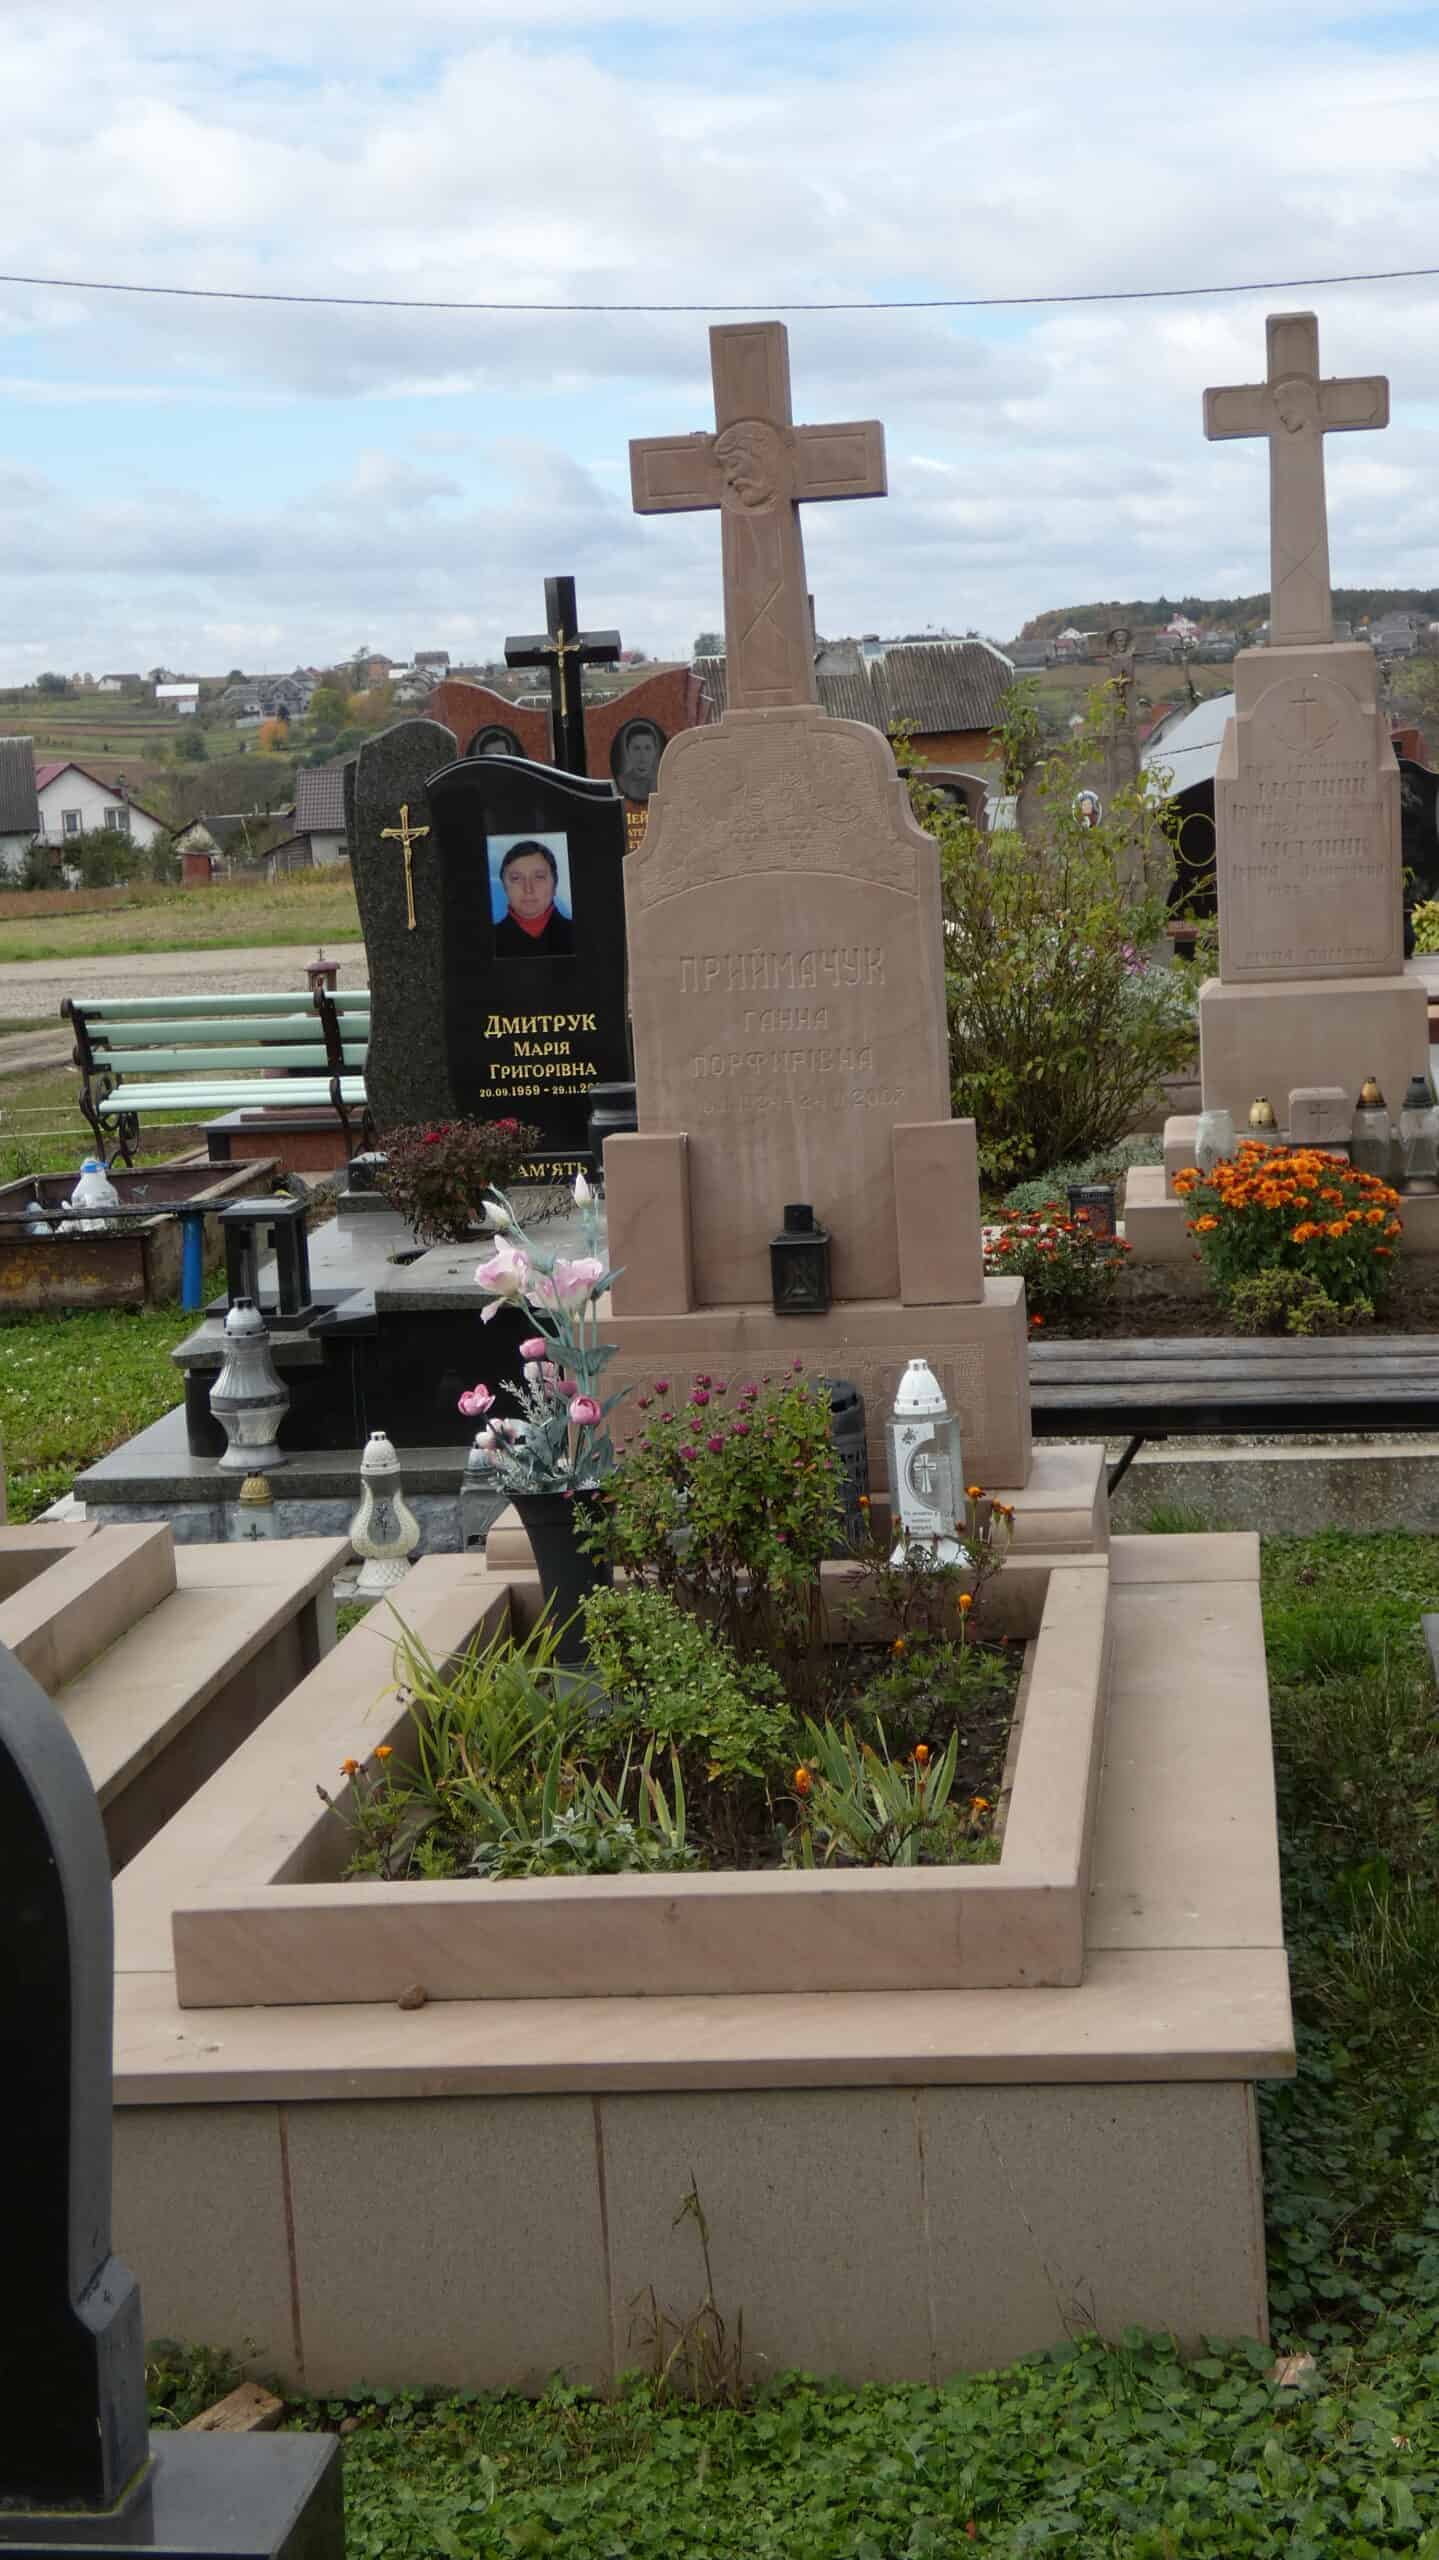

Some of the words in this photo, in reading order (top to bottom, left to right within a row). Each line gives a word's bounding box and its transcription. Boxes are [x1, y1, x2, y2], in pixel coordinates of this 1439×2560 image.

[679, 945, 886, 993] ПРИЙМАЧУК
[484, 1013, 598, 1039] ДМИТРУК
[743, 1007, 830, 1033] ГАННА
[513, 1040, 571, 1057] МАРІЯ
[489, 1061, 598, 1079] ГРИГОРІВНА
[516, 1162, 588, 1178] АМ'ЯТЬ
